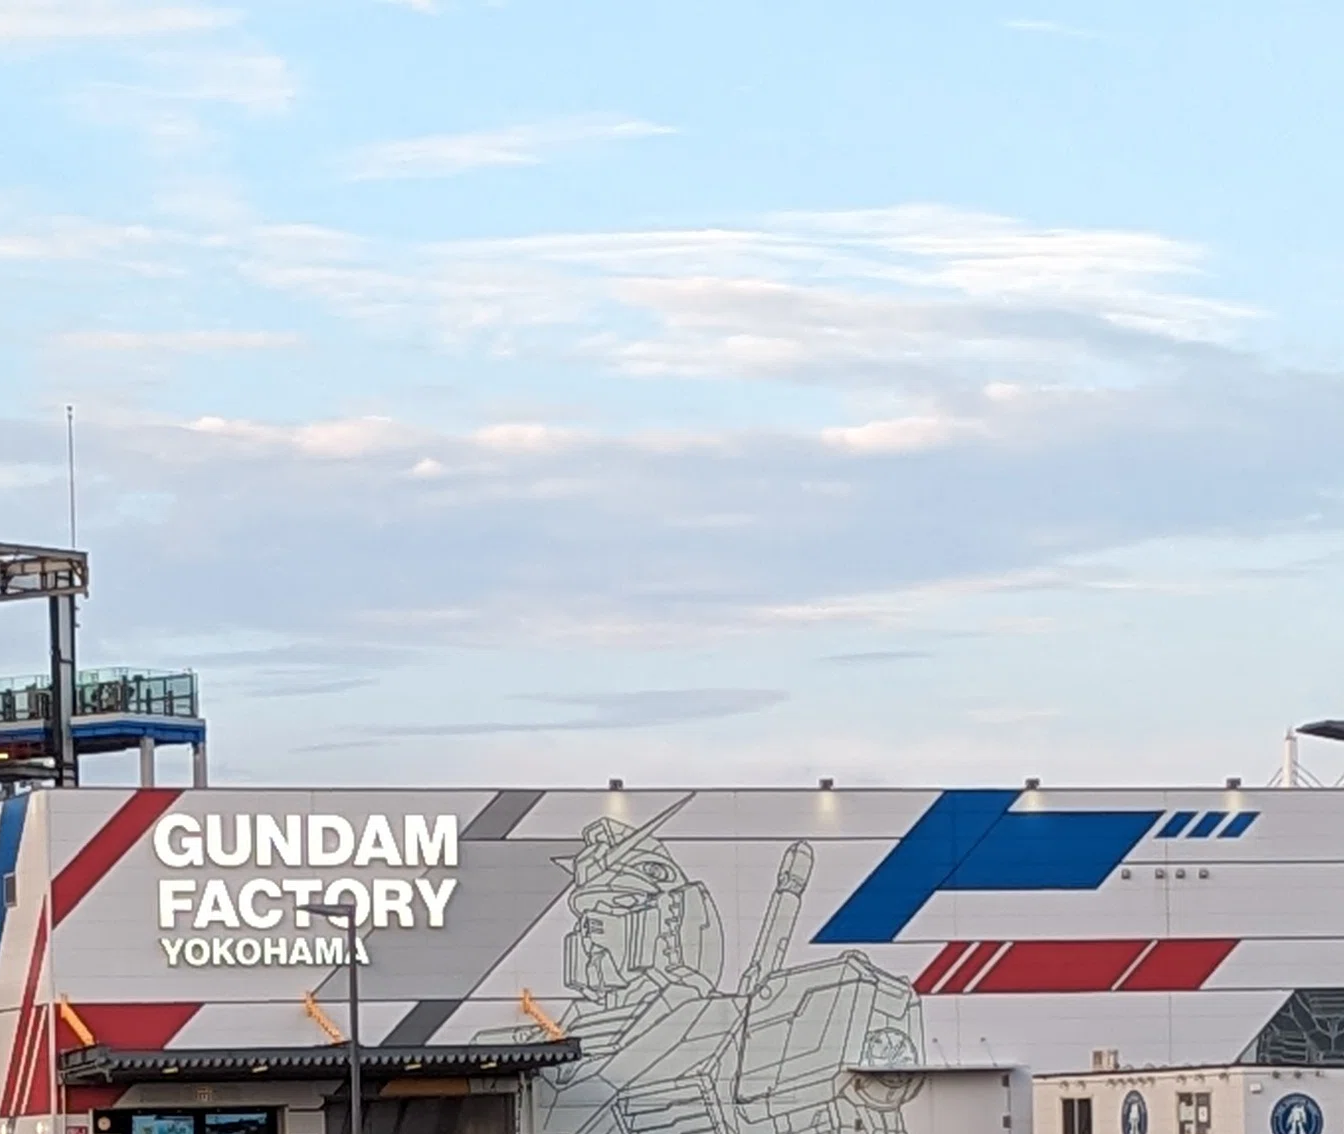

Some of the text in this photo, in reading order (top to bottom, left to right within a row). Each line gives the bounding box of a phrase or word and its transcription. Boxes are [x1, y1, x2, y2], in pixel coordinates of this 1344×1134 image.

[153, 813, 457, 867] GUNDAM
[158, 878, 458, 929] FACTORY
[160, 937, 371, 966] YOKOHAMA
